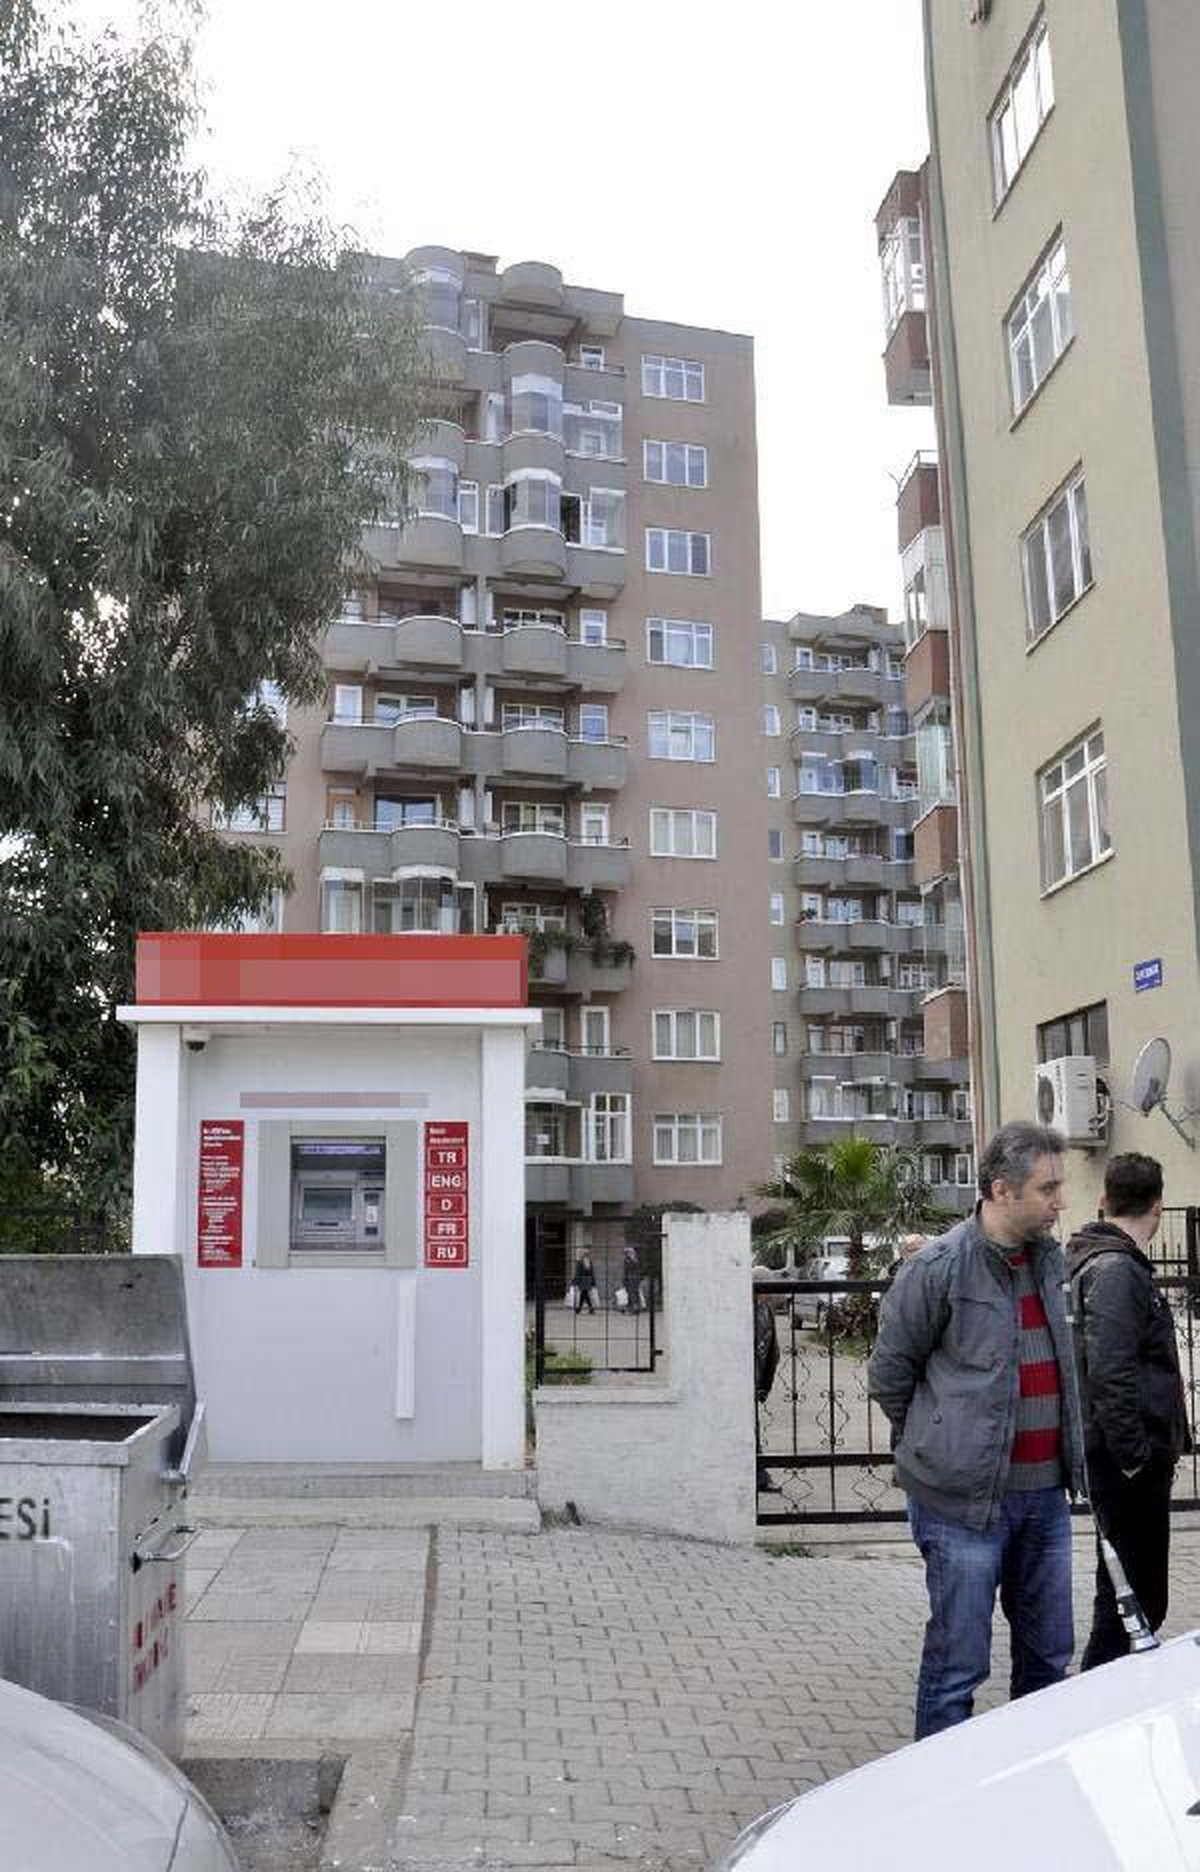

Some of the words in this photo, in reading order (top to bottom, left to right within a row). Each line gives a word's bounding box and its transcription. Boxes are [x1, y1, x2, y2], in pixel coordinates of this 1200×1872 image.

[437, 1151, 457, 1163] TR
[431, 1175, 461, 1187] ENG
[441, 1199, 452, 1210] D
[437, 1222, 457, 1235] FR
